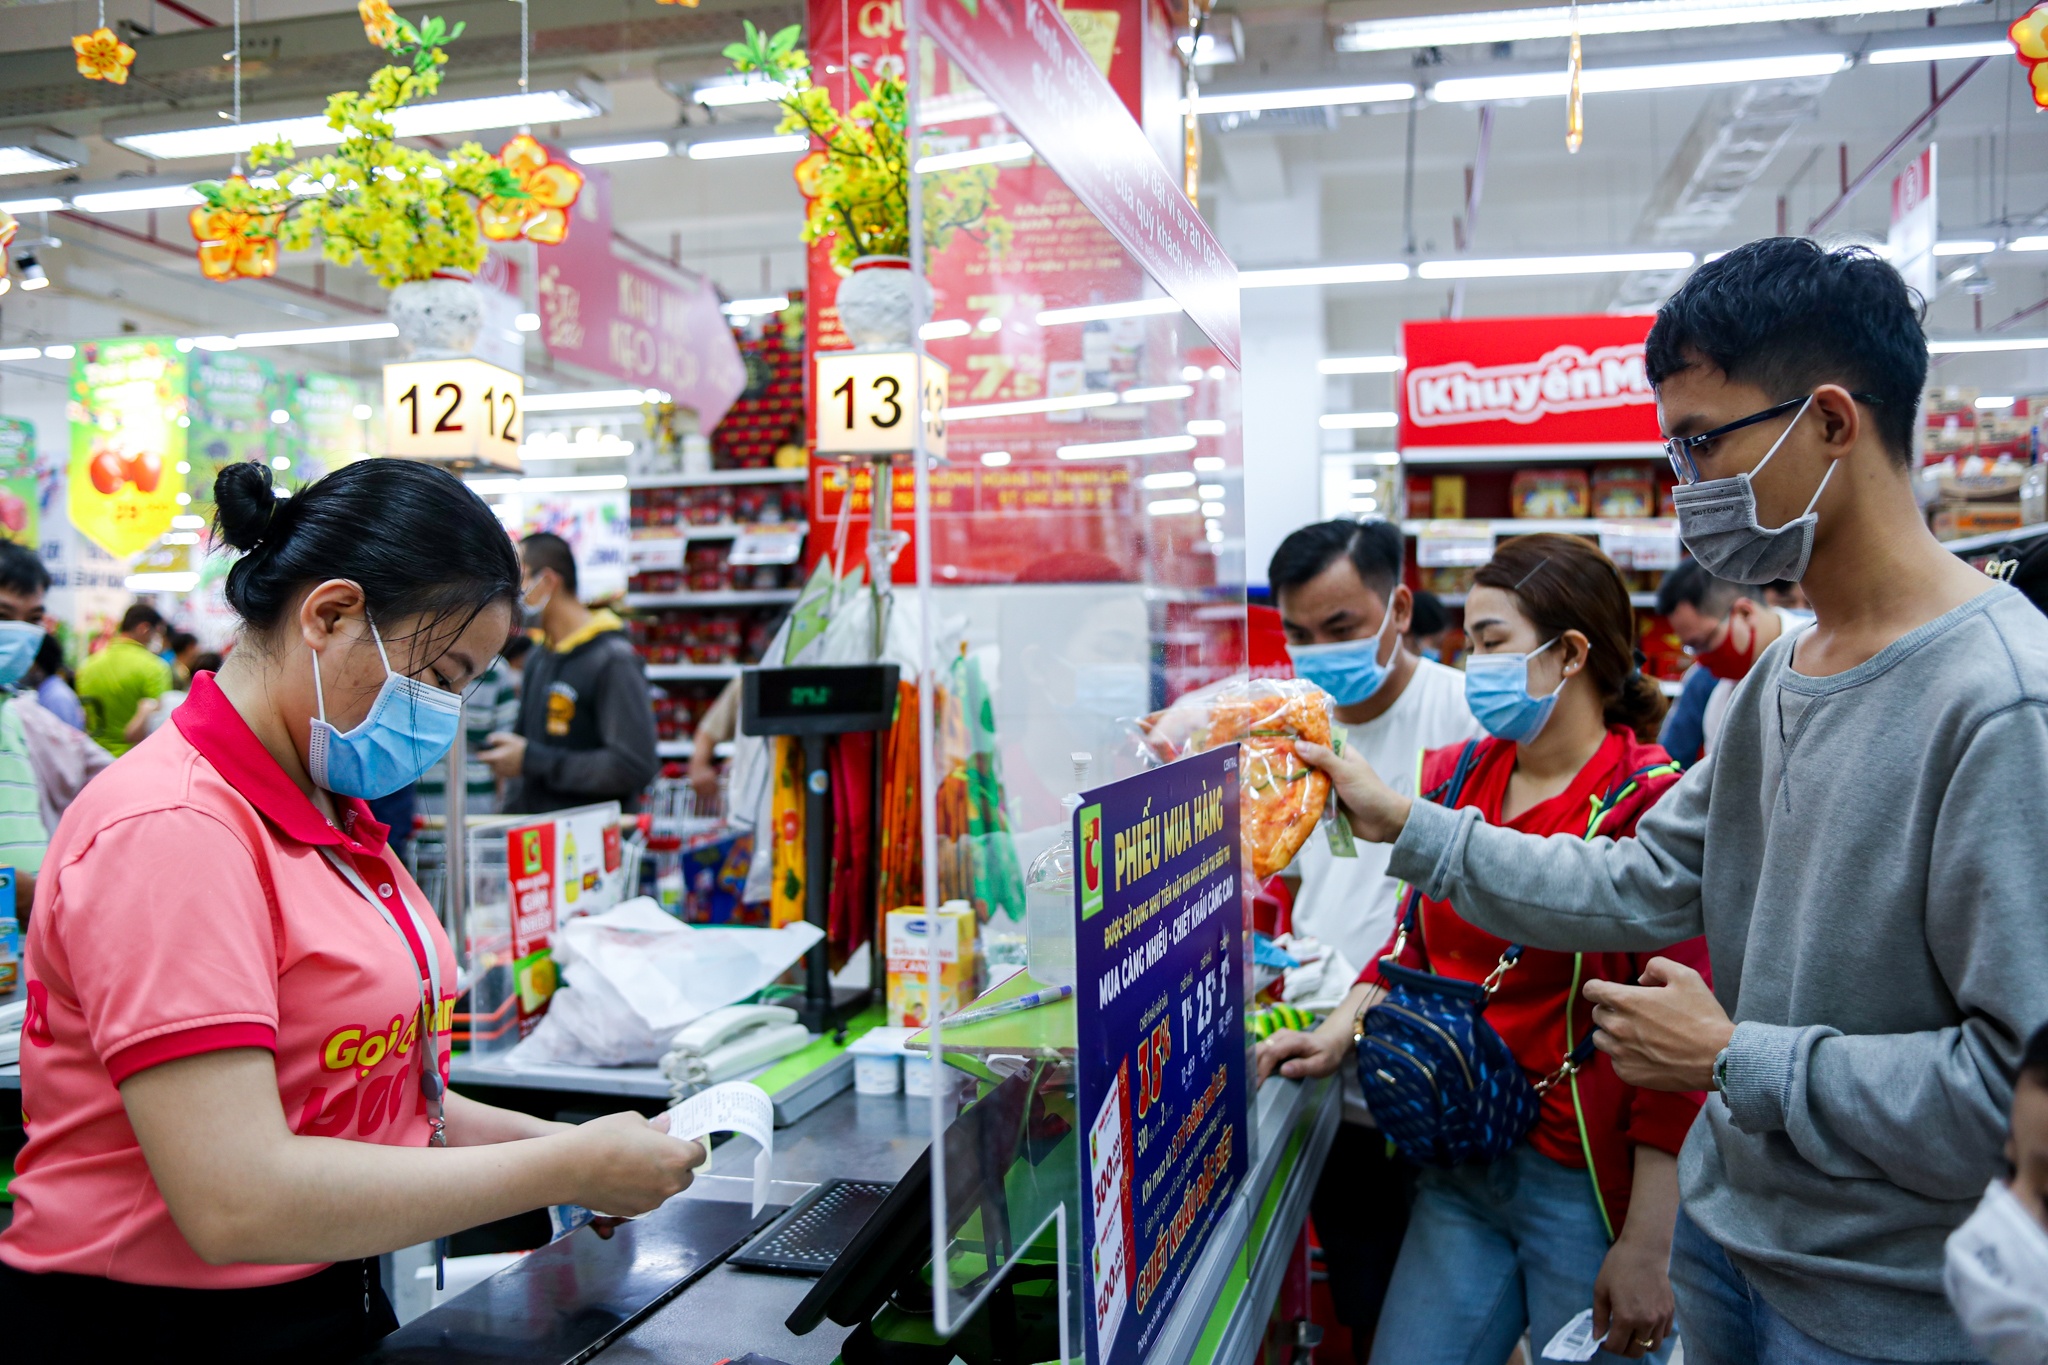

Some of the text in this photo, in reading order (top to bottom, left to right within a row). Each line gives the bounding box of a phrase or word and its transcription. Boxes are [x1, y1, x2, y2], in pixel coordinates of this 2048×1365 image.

[1114, 168, 1134, 211] của
[1136, 197, 1155, 241] quý
[1157, 214, 1183, 269] khách
[1151, 168, 1166, 211] đặt
[1177, 207, 1189, 241] sự
[1189, 221, 1201, 254] an
[1203, 235, 1222, 280] toàn
[832, 375, 902, 431] 13
[1600, 353, 1656, 398] M
[400, 382, 463, 436] 12
[484, 384, 517, 443] 12
[1115, 780, 1223, 891] PHIẾU MUA HÀNG
[1100, 966, 1119, 1009] MUA
[1122, 946, 1144, 989] CÀNG
[1146, 921, 1167, 969] NHIỀU
[1173, 901, 1190, 945] CHIẾT
[1192, 889, 1206, 930] KHẤU
[1208, 883, 1222, 915] CÀNG
[1223, 875, 1233, 902] CAO
[1104, 918, 1122, 949] ĐƯỢC
[1124, 905, 1132, 935] SỬ
[1133, 900, 1148, 930] DỤNG
[1149, 890, 1160, 917] NHƯ
[1161, 880, 1172, 908] TIỀN
[1220, 953, 1229, 1006] 3%
[321, 1016, 403, 1080] Gọi
[1182, 995, 1192, 1054] 1%
[1138, 1014, 1171, 1119] 3.5%
[1138, 1124, 1148, 1157] 500
[1142, 1174, 1151, 1206] Khi
[1153, 1160, 1165, 1190] mua
[1136, 1223, 1168, 1315] CHIẾT
[1170, 1180, 1196, 1260] KHẤU
[1196, 1154, 1215, 1212] ĐẶC
[1214, 1124, 1232, 1179] BIỆT
